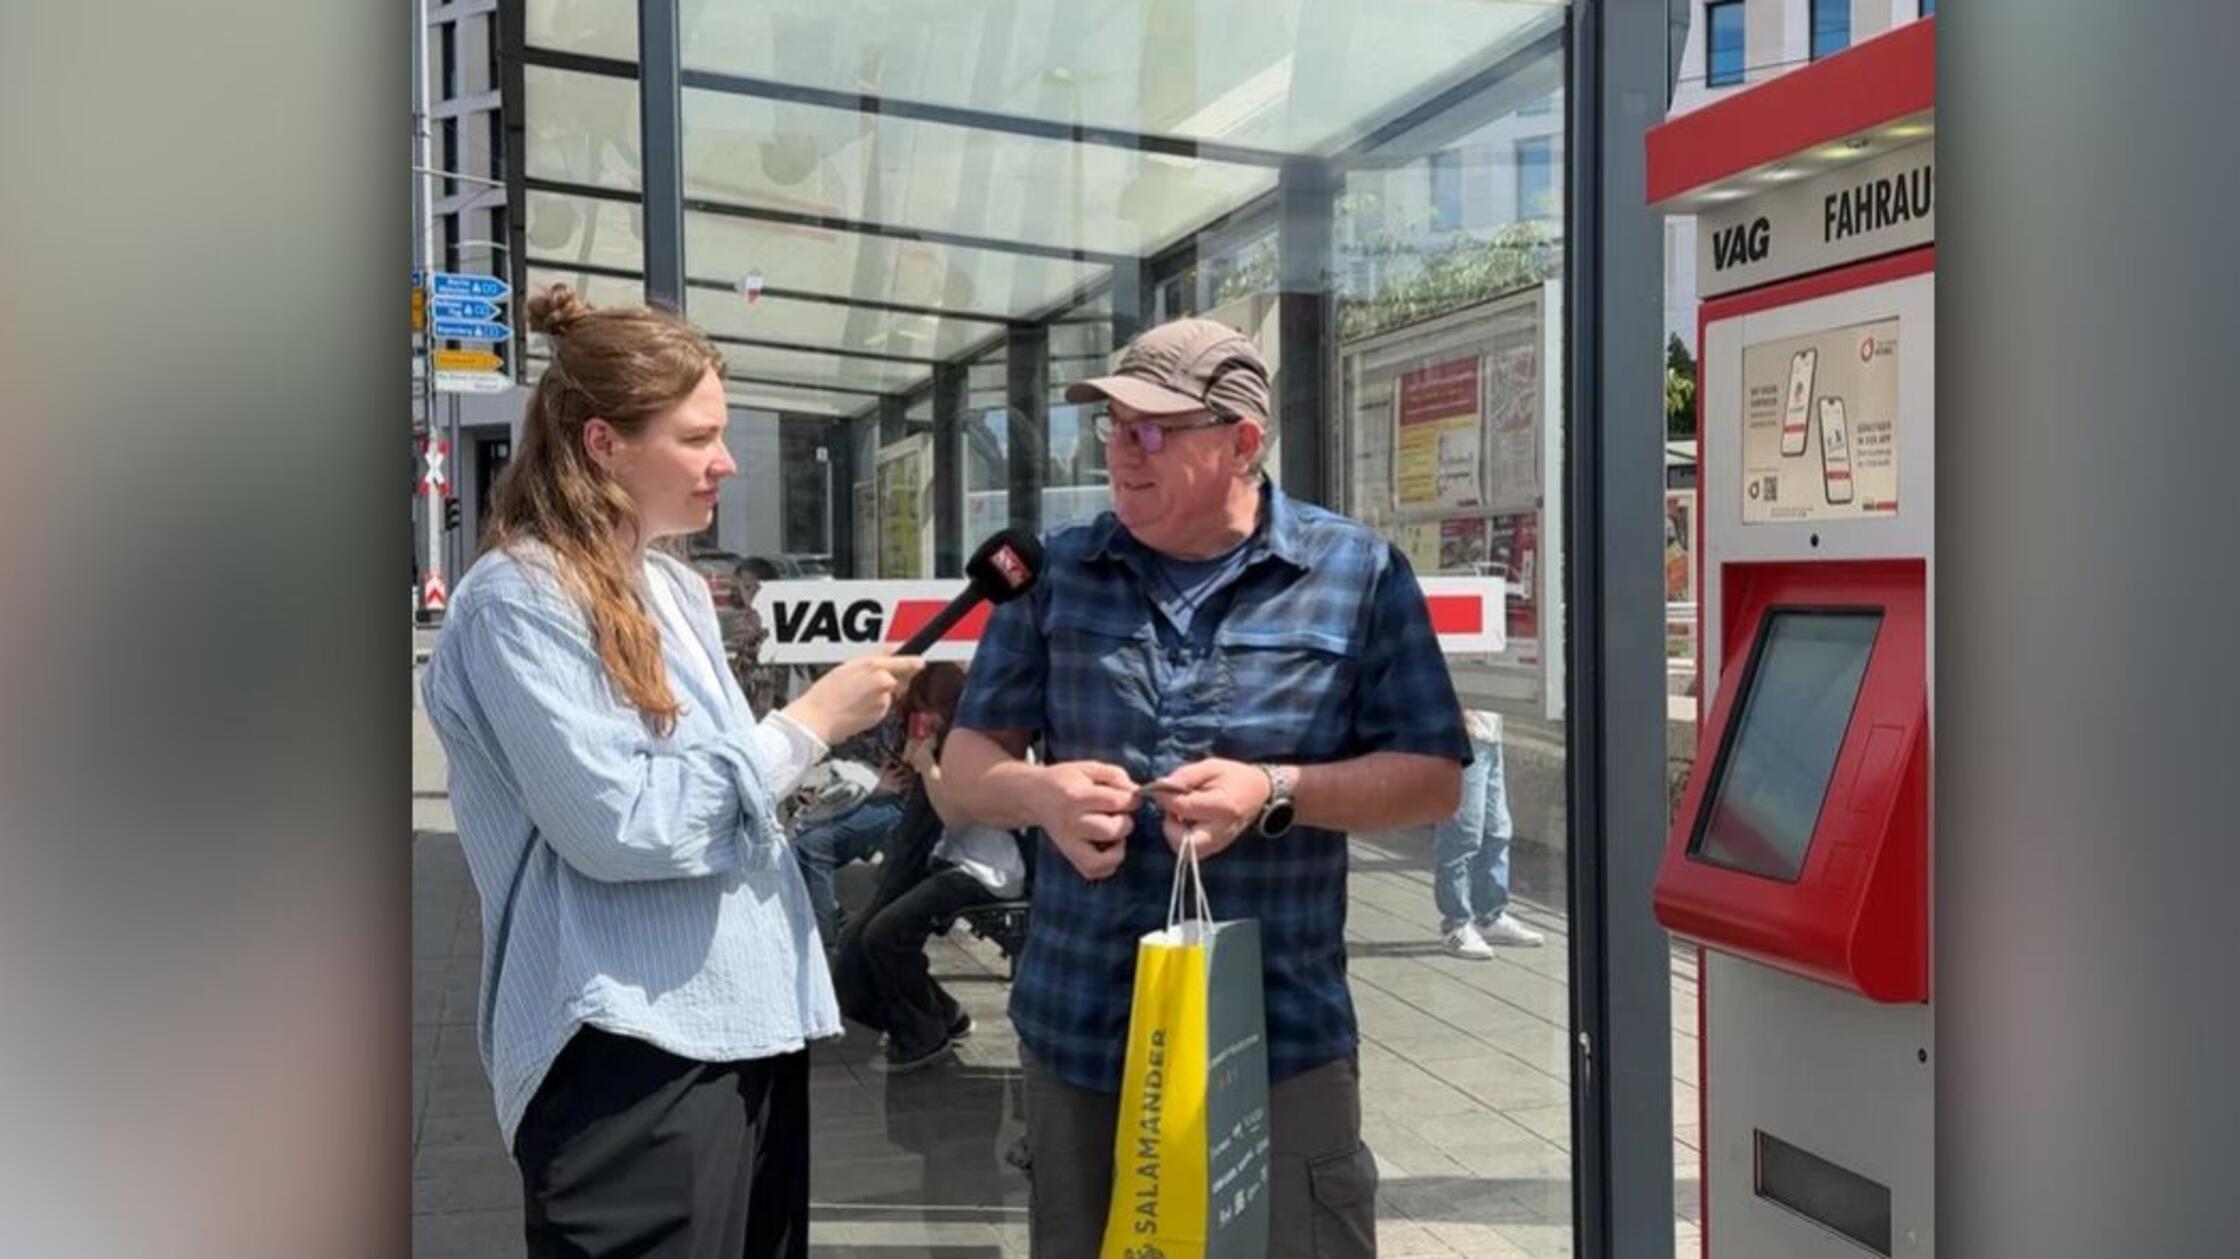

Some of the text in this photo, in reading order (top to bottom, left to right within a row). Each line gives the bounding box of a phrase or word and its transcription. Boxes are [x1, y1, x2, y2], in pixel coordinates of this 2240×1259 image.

[1712, 165, 1934, 271] VAG FAHRAU
[773, 599, 884, 643] VAG
[1135, 1028, 1167, 1235] SALAMANDER
